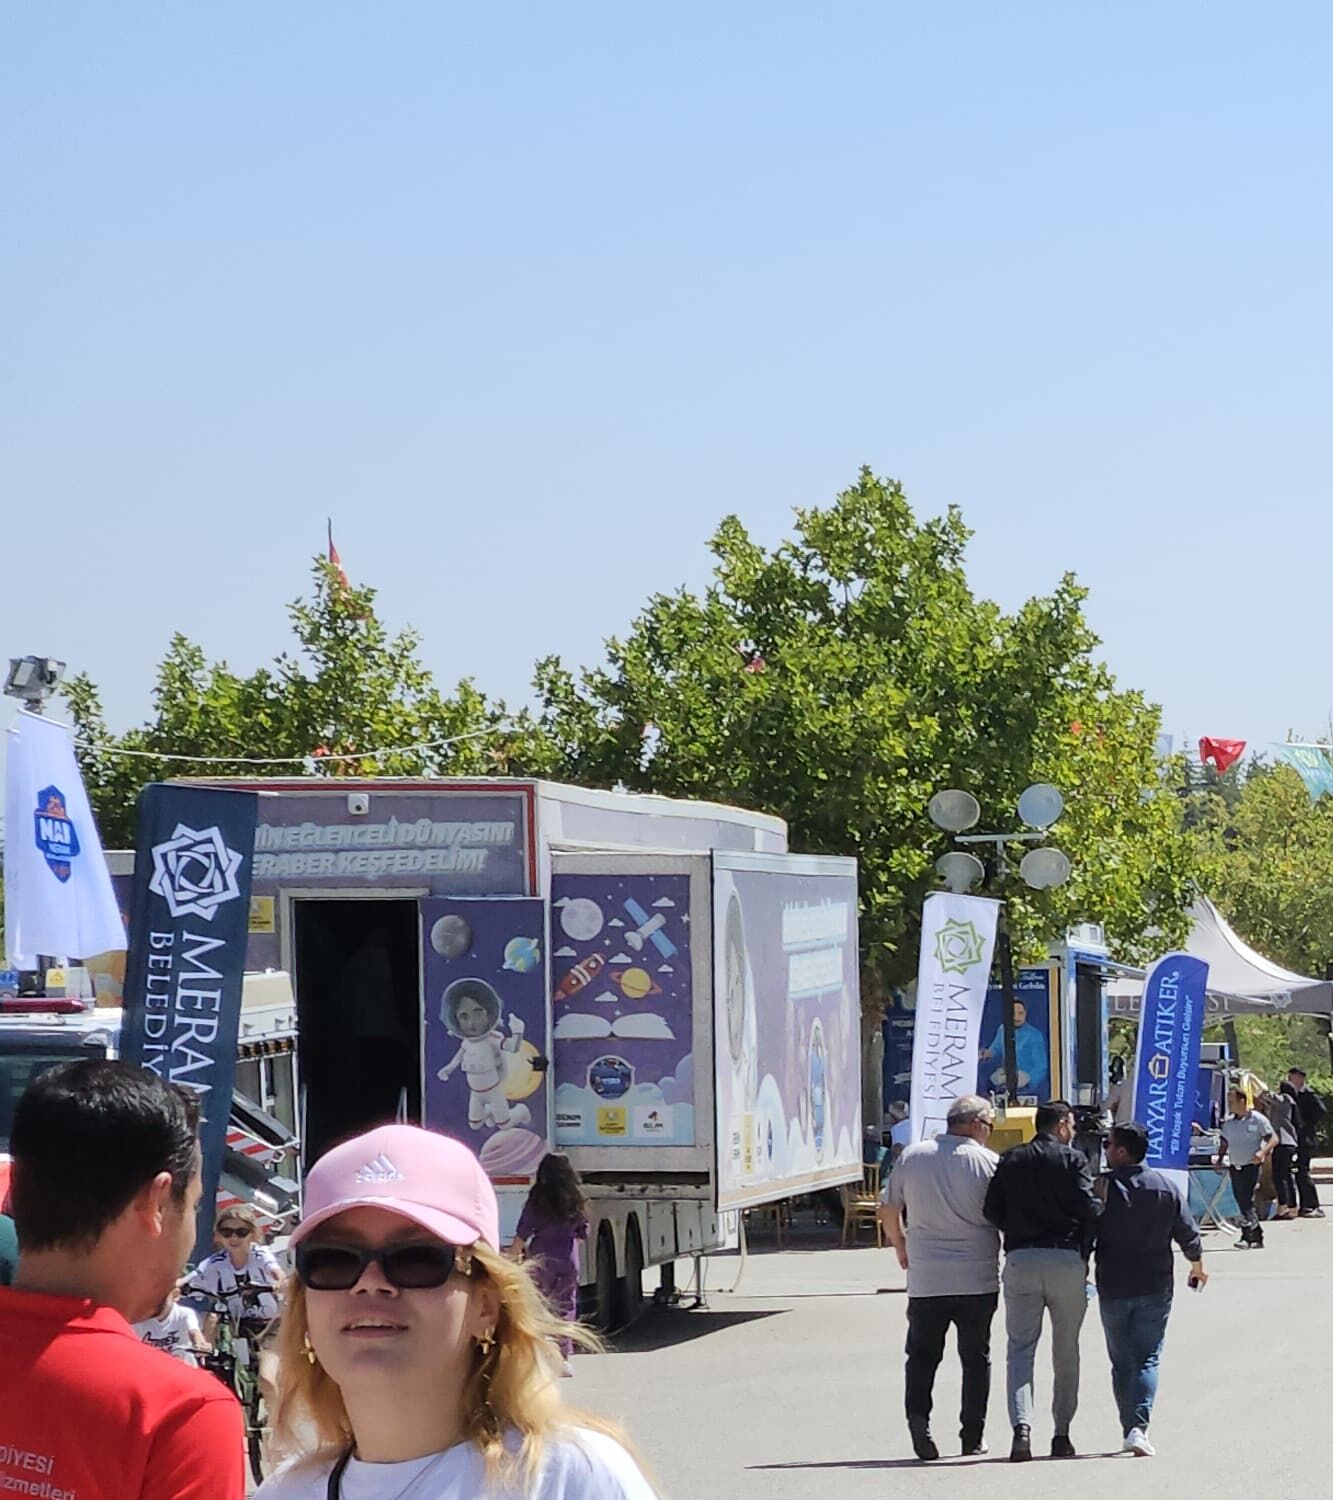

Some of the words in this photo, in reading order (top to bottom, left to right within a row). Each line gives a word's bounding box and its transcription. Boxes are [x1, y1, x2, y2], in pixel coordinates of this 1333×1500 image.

[252, 851, 335, 879] ERABER
[141, 932, 175, 1077] BELEDİY
[939, 983, 972, 1101] MERAM
